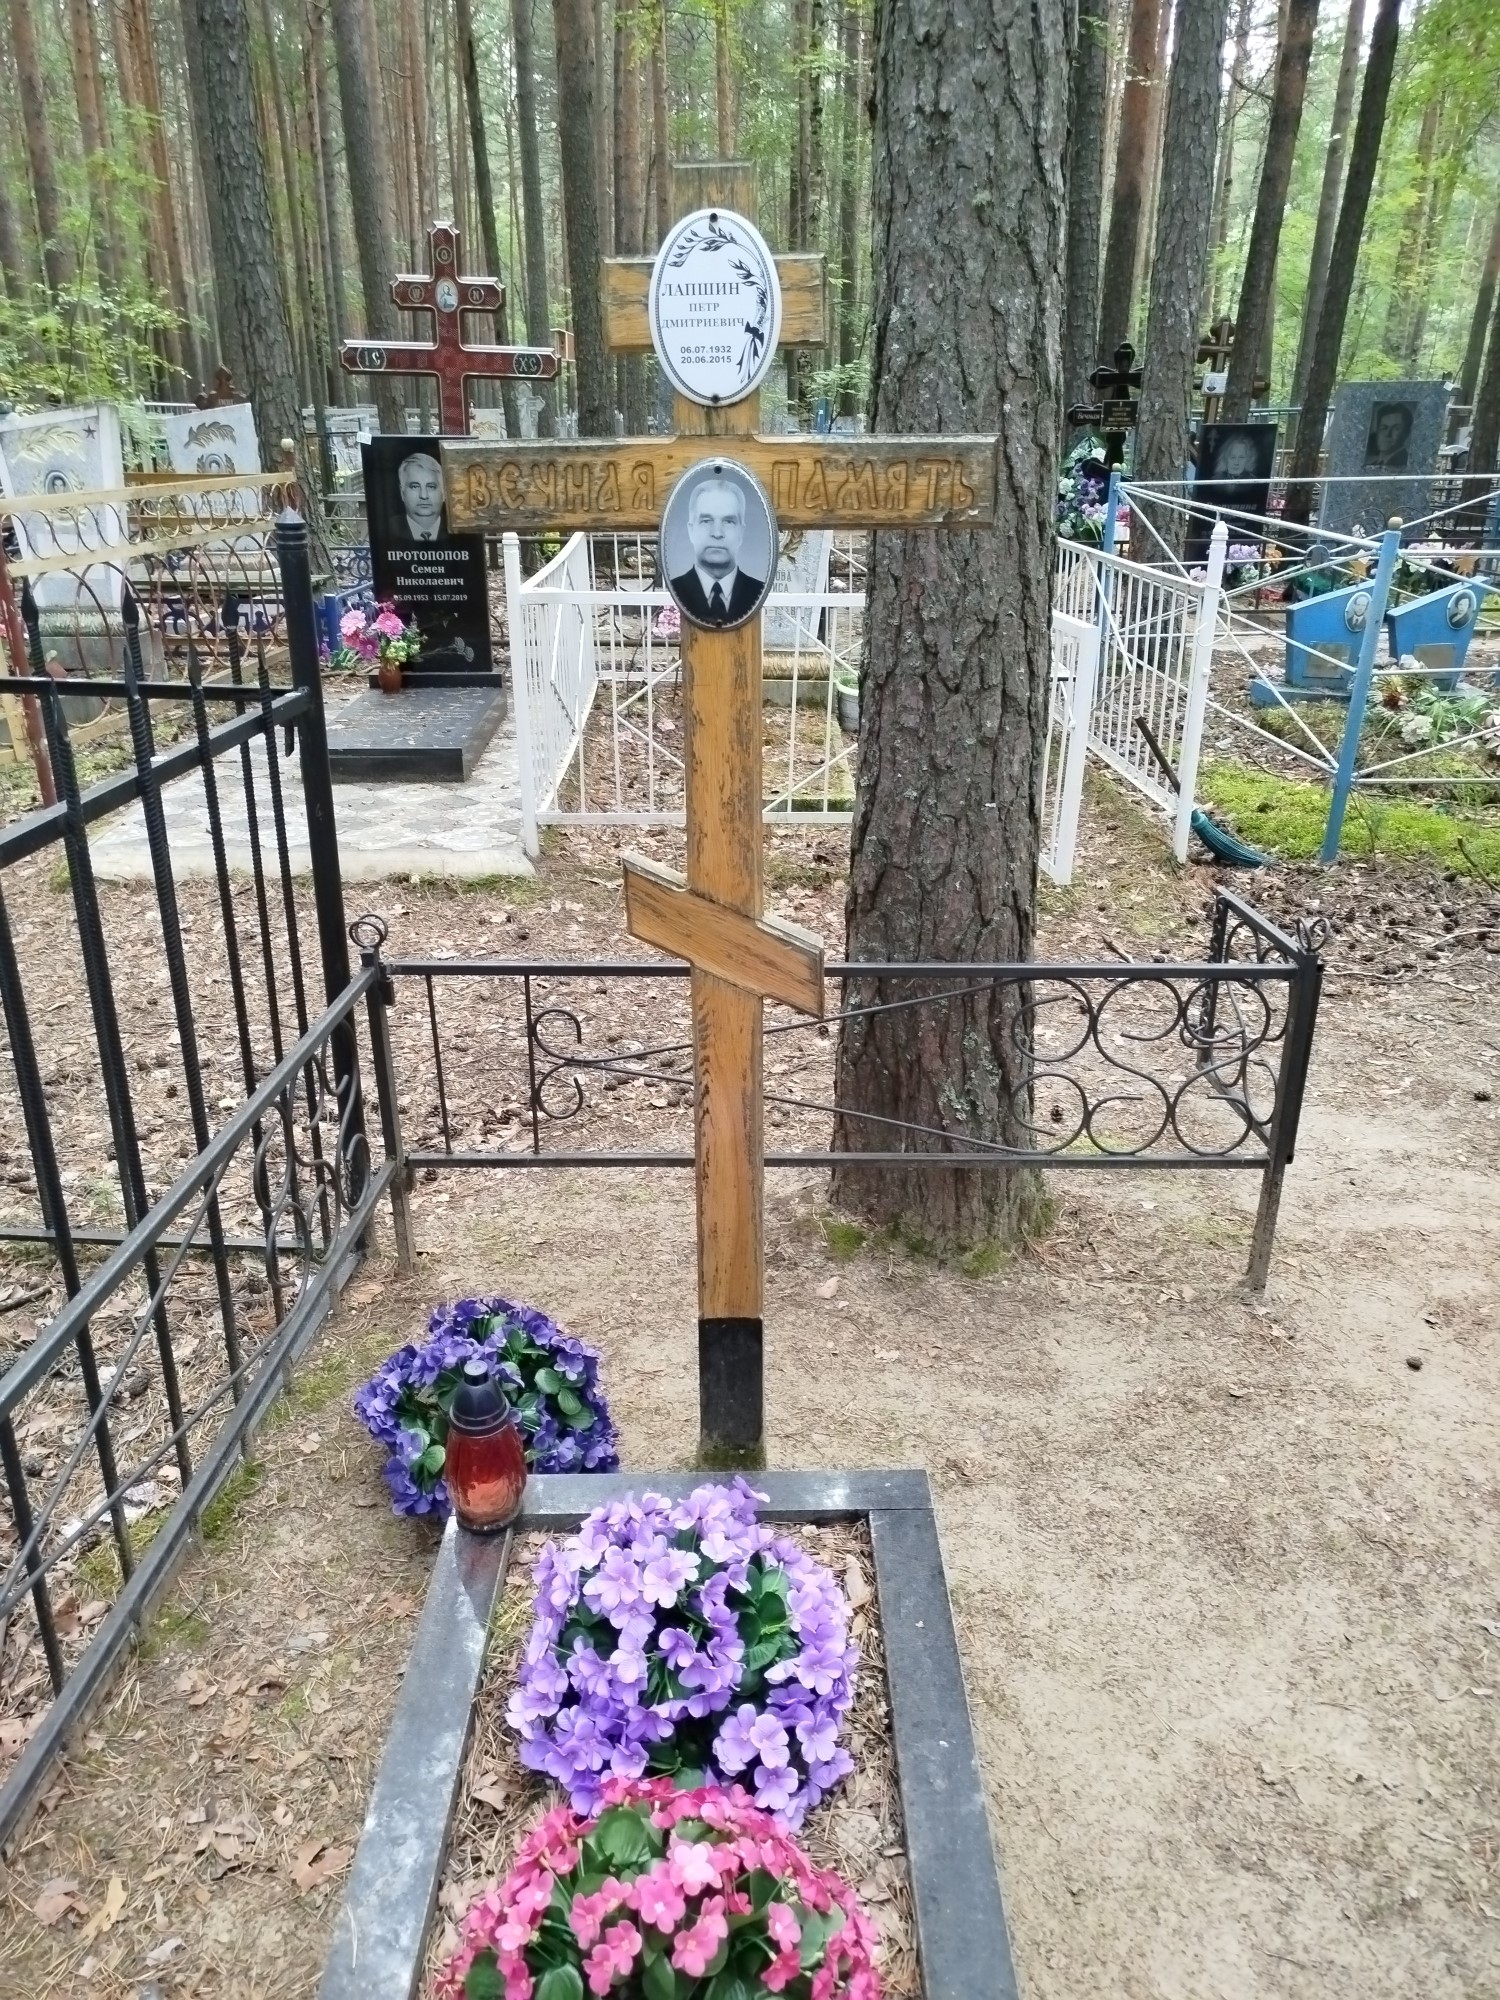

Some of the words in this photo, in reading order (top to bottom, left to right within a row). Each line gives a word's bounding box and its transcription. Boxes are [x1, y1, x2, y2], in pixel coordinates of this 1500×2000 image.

[661, 282, 740, 297] ЛАПШИН
[689, 302, 720, 312] ПЕТР
[661, 317, 745, 329] ДМИТРИЕВИЧ
[680, 345, 732, 354] 06.07.1932
[680, 355, 732, 364] 20.06.2015
[465, 459, 656, 511] ВЕЧНАЯ
[771, 458, 976, 512] ПАМЯТЬ
[387, 550, 470, 561] ПРОТОПОПОВ
[411, 564, 445, 574] Семен
[396, 576, 465, 586] Николаевич
